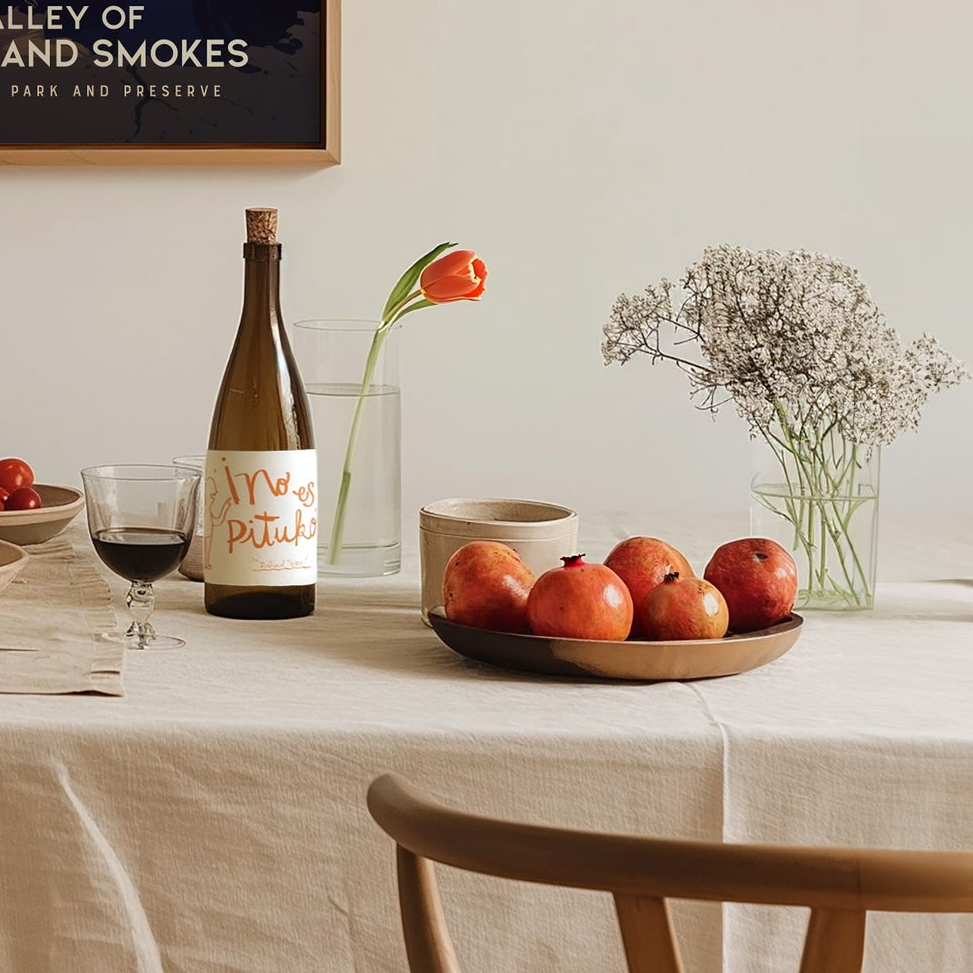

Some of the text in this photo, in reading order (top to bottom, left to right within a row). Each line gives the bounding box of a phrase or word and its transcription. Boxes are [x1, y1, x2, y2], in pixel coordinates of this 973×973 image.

[101, 5, 145, 30] OF
[92, 38, 249, 68] SMOKES
[11, 84, 58, 97] PARK
[73, 84, 109, 97] AND
[124, 84, 221, 97] PRESERVE
[292, 481, 315, 507] es
